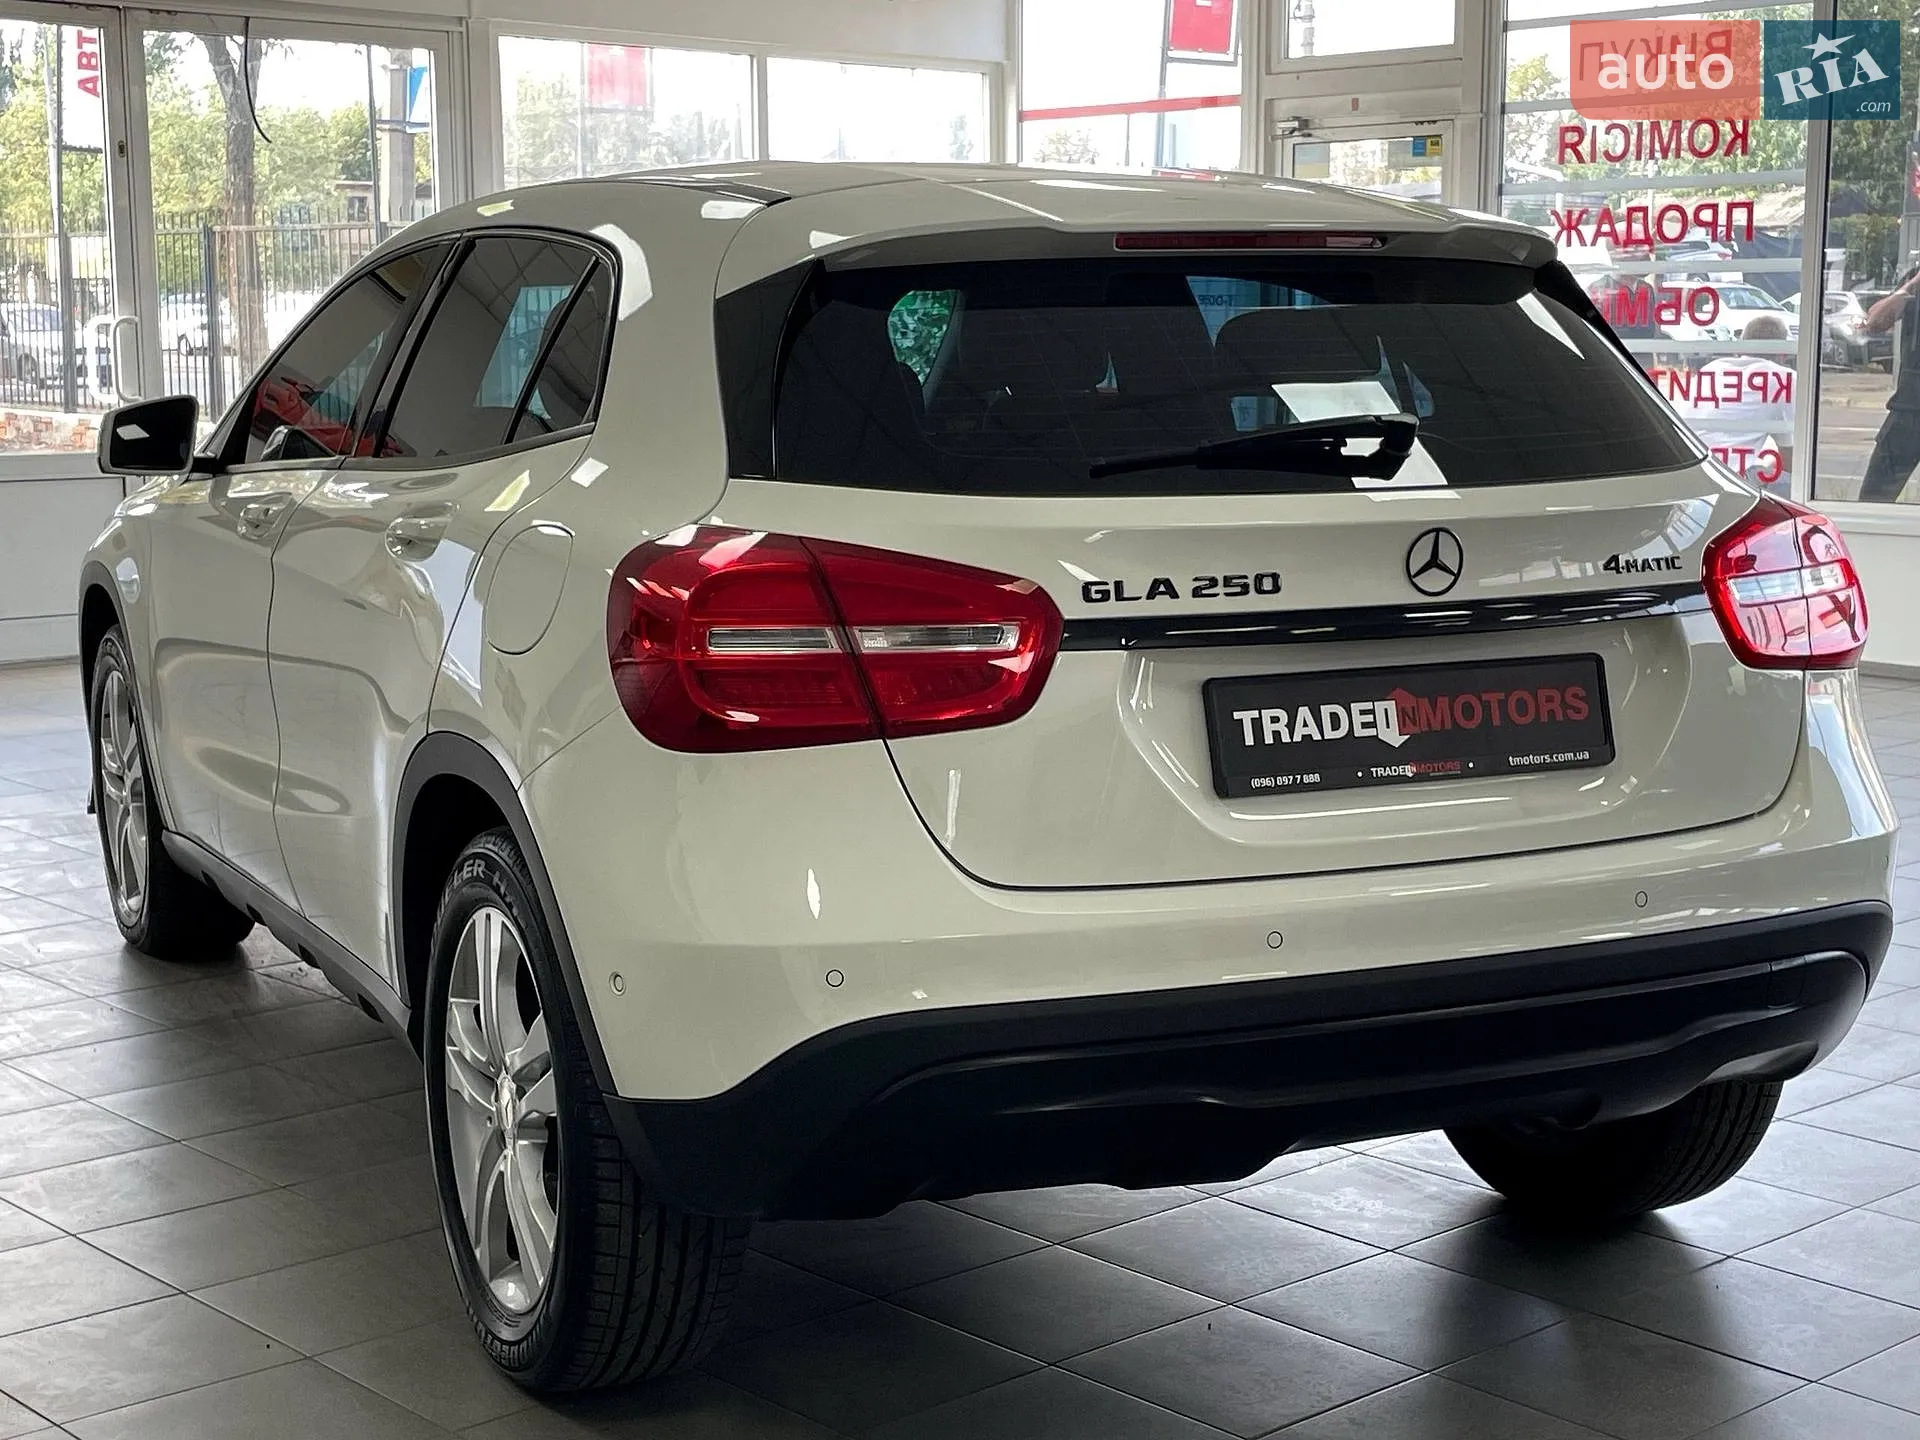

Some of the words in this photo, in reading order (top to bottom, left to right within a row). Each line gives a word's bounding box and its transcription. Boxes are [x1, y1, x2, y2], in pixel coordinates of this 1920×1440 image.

[1081, 577, 1181, 604] GLA
[1191, 571, 1282, 599] 250
[1508, 750, 1590, 766] tmotors.com.ua
[1251, 776, 1275, 789] (096)
